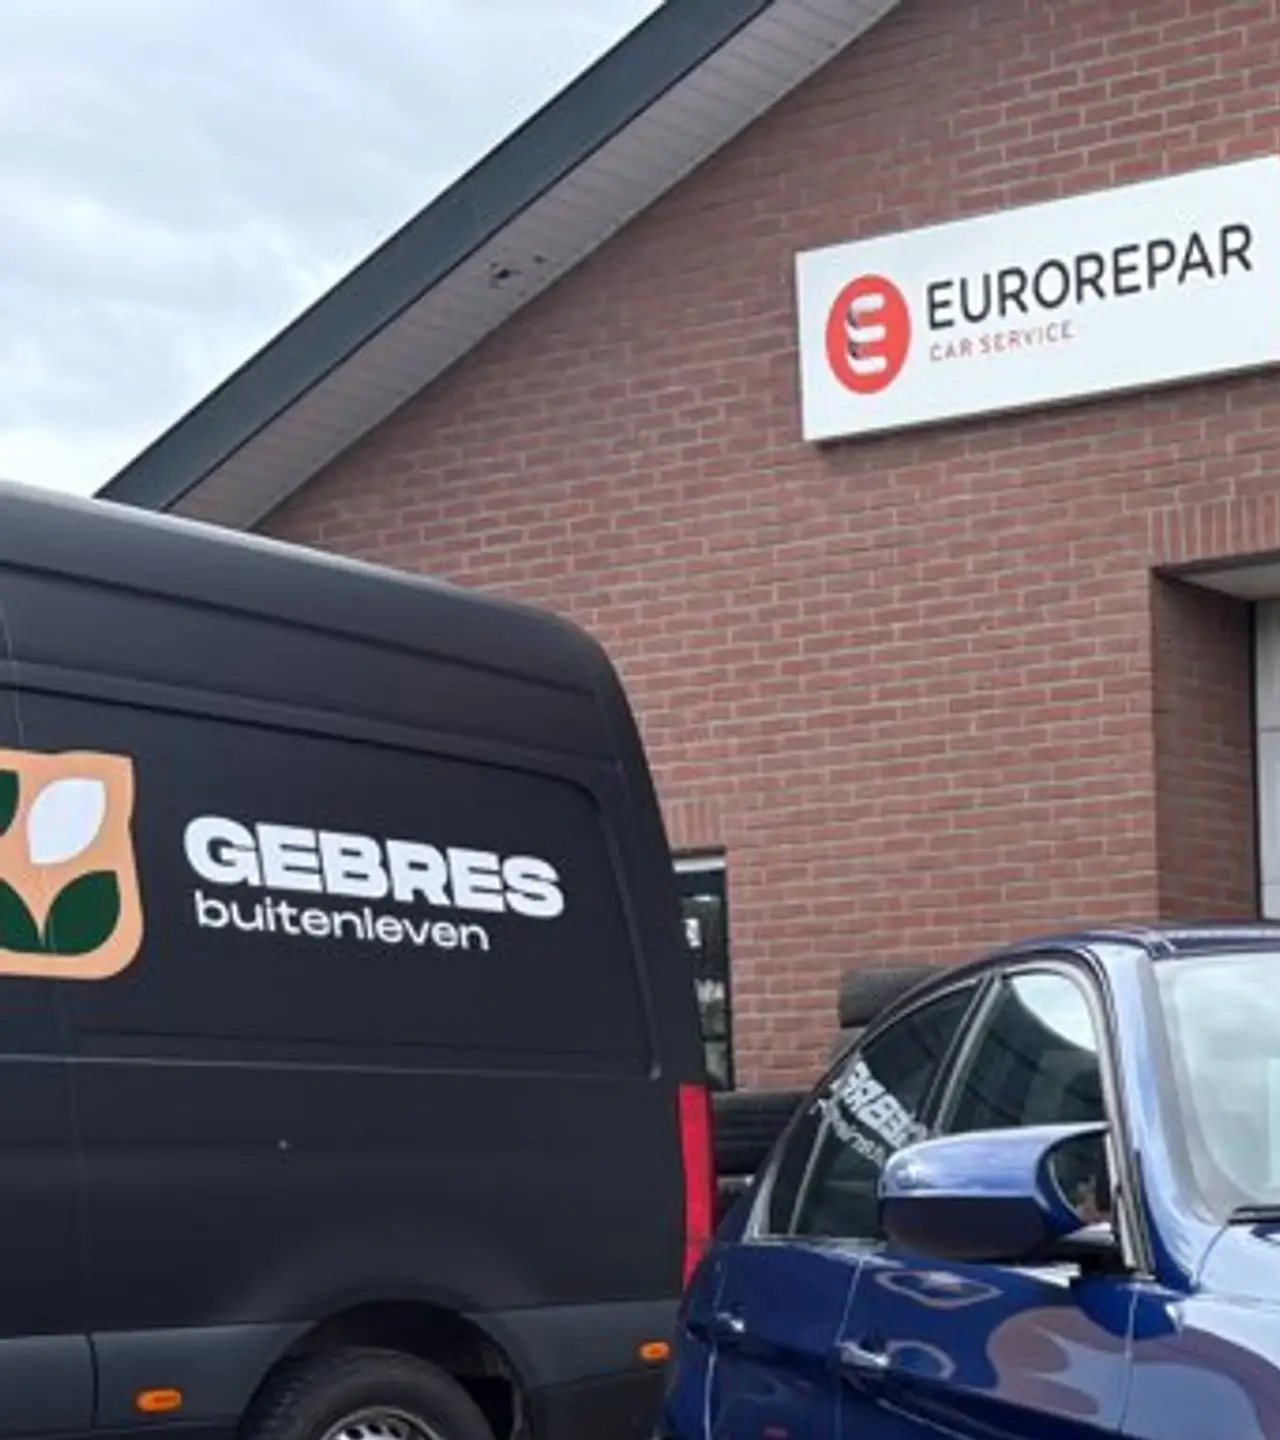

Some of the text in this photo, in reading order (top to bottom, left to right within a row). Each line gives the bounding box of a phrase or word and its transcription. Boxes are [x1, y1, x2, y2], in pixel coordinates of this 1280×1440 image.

[926, 222, 1254, 331] EUROREPAR
[928, 319, 1077, 363] CAR SERVICE
[184, 815, 565, 919] GEBRES
[194, 888, 491, 951] buitenleven
